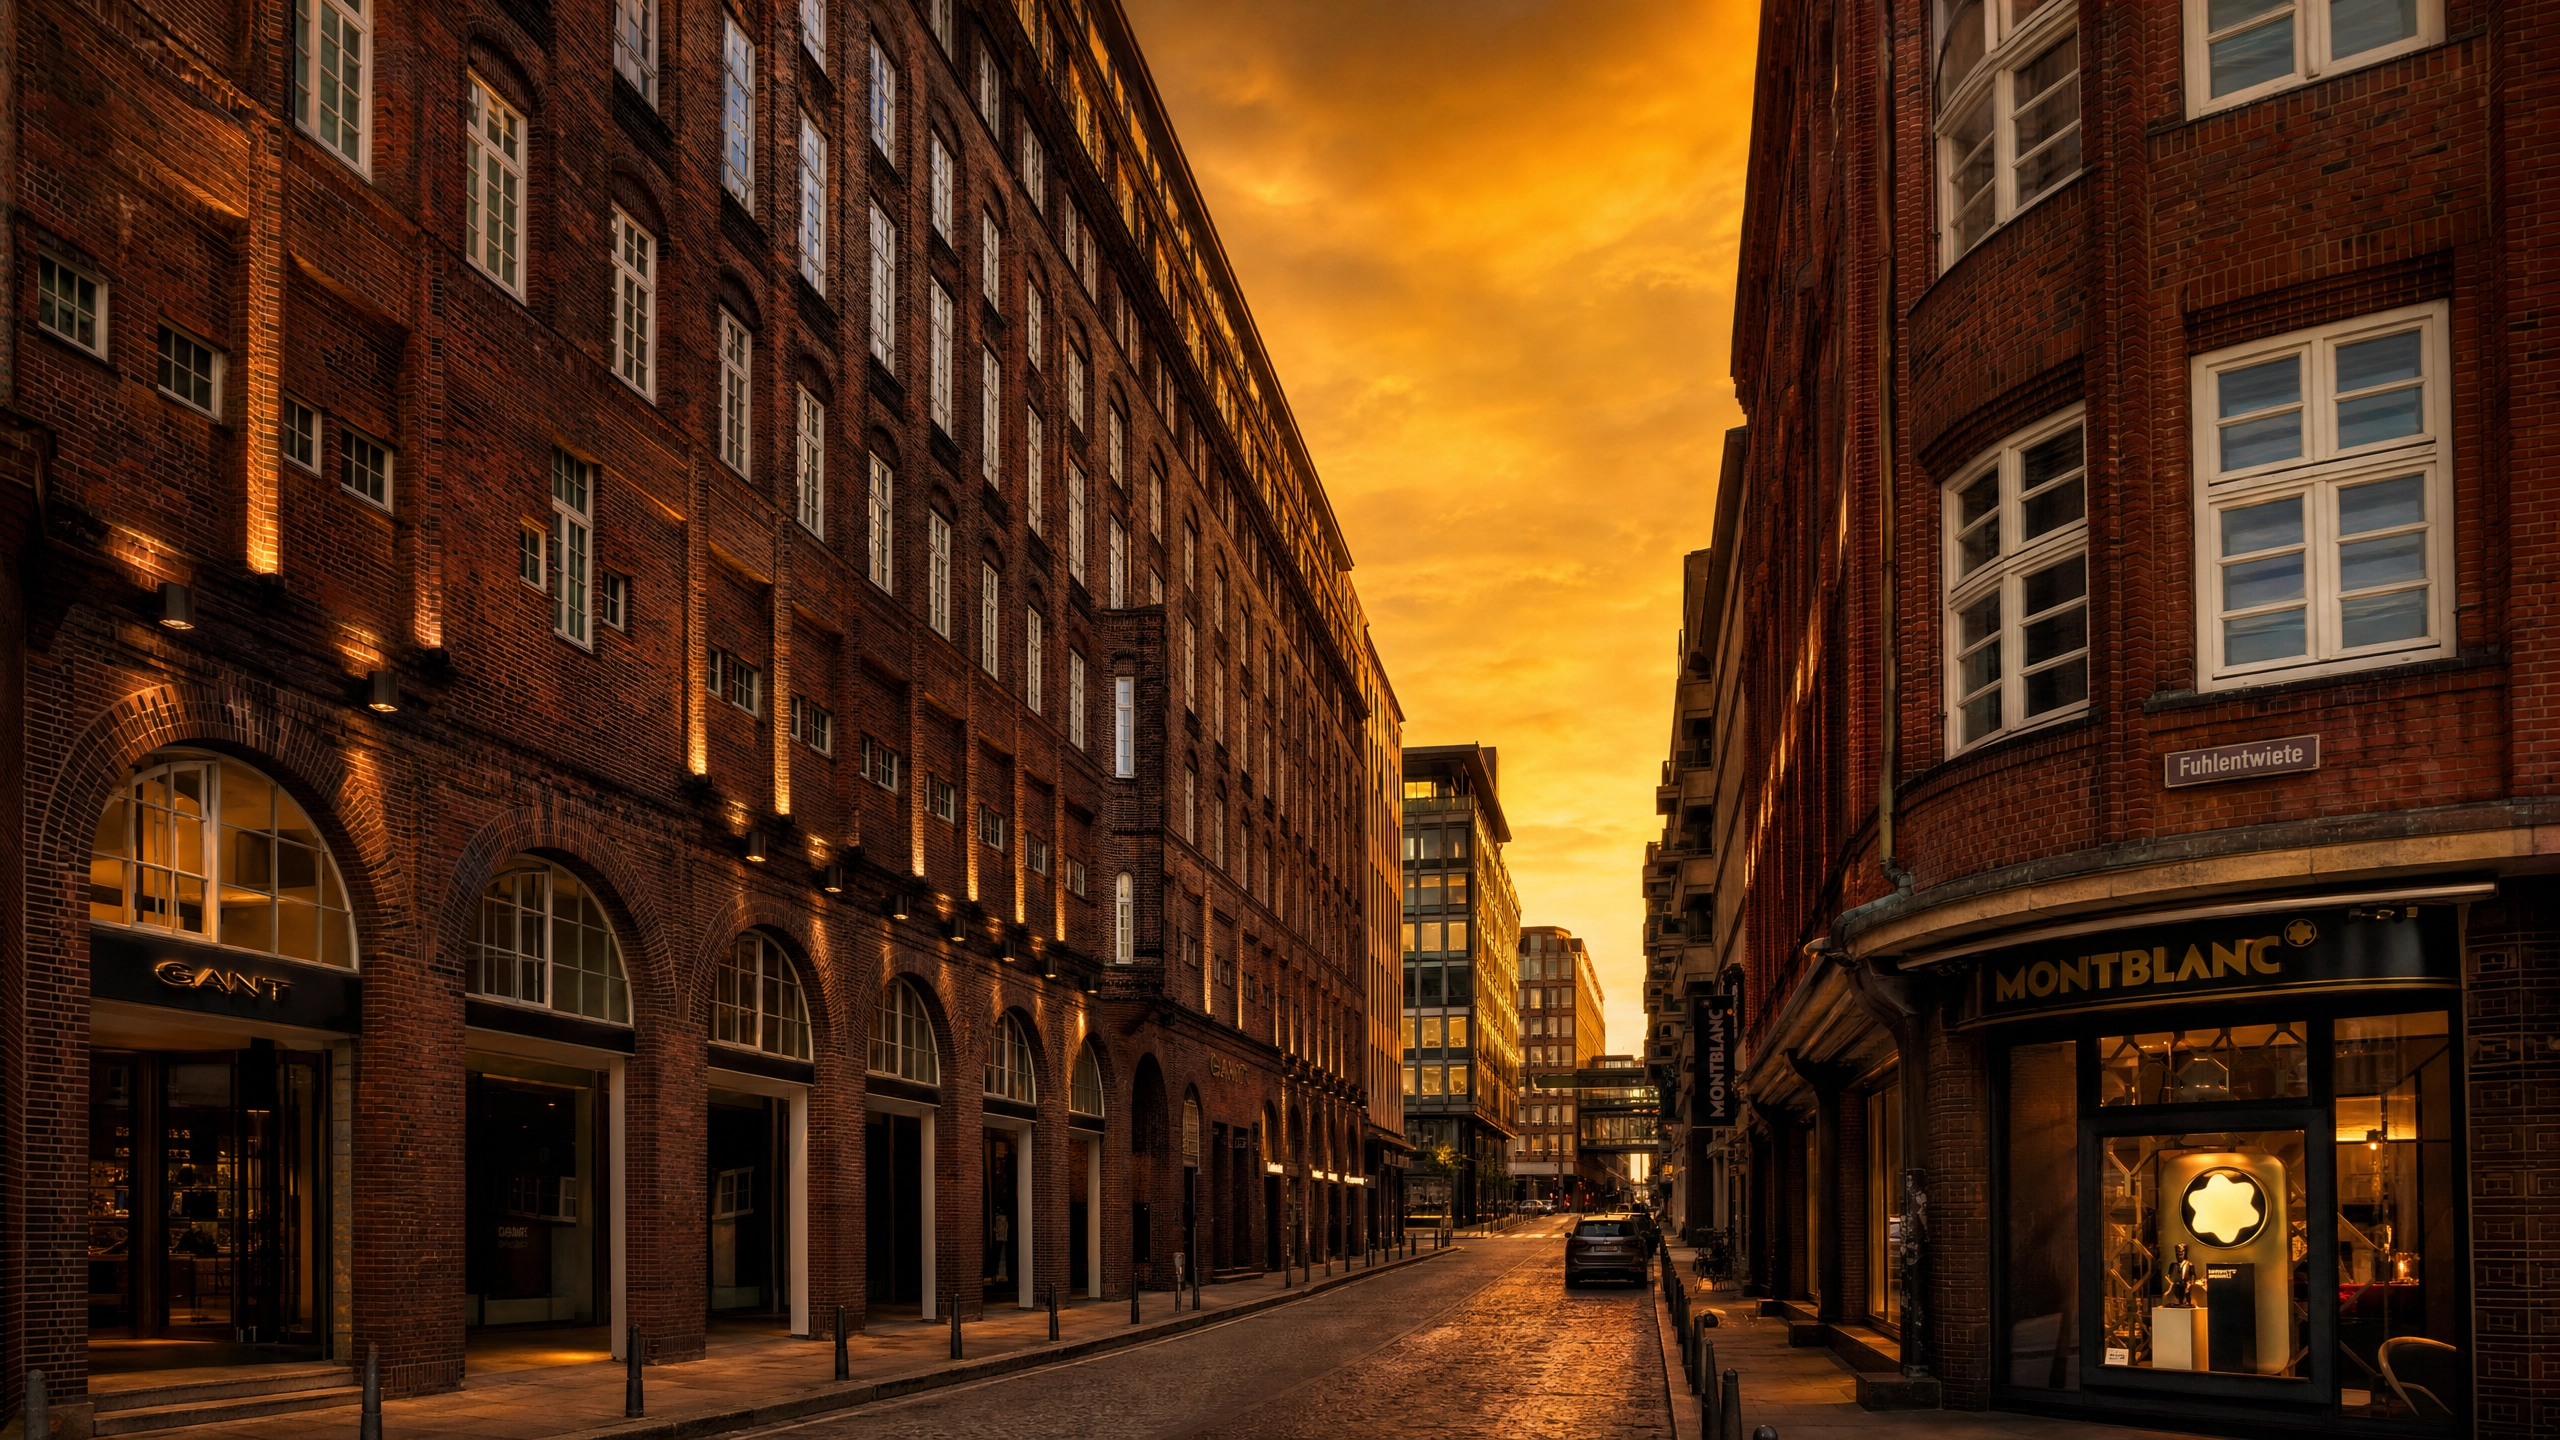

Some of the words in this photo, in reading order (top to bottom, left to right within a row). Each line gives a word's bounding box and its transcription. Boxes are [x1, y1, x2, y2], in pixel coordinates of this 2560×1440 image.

[2180, 745, 2303, 777] Fuhlentwiete
[155, 961, 296, 1001] GANT
[1996, 935, 2283, 1003] MONTBLANC
[1708, 1008, 1725, 1118] MONTBLANC
